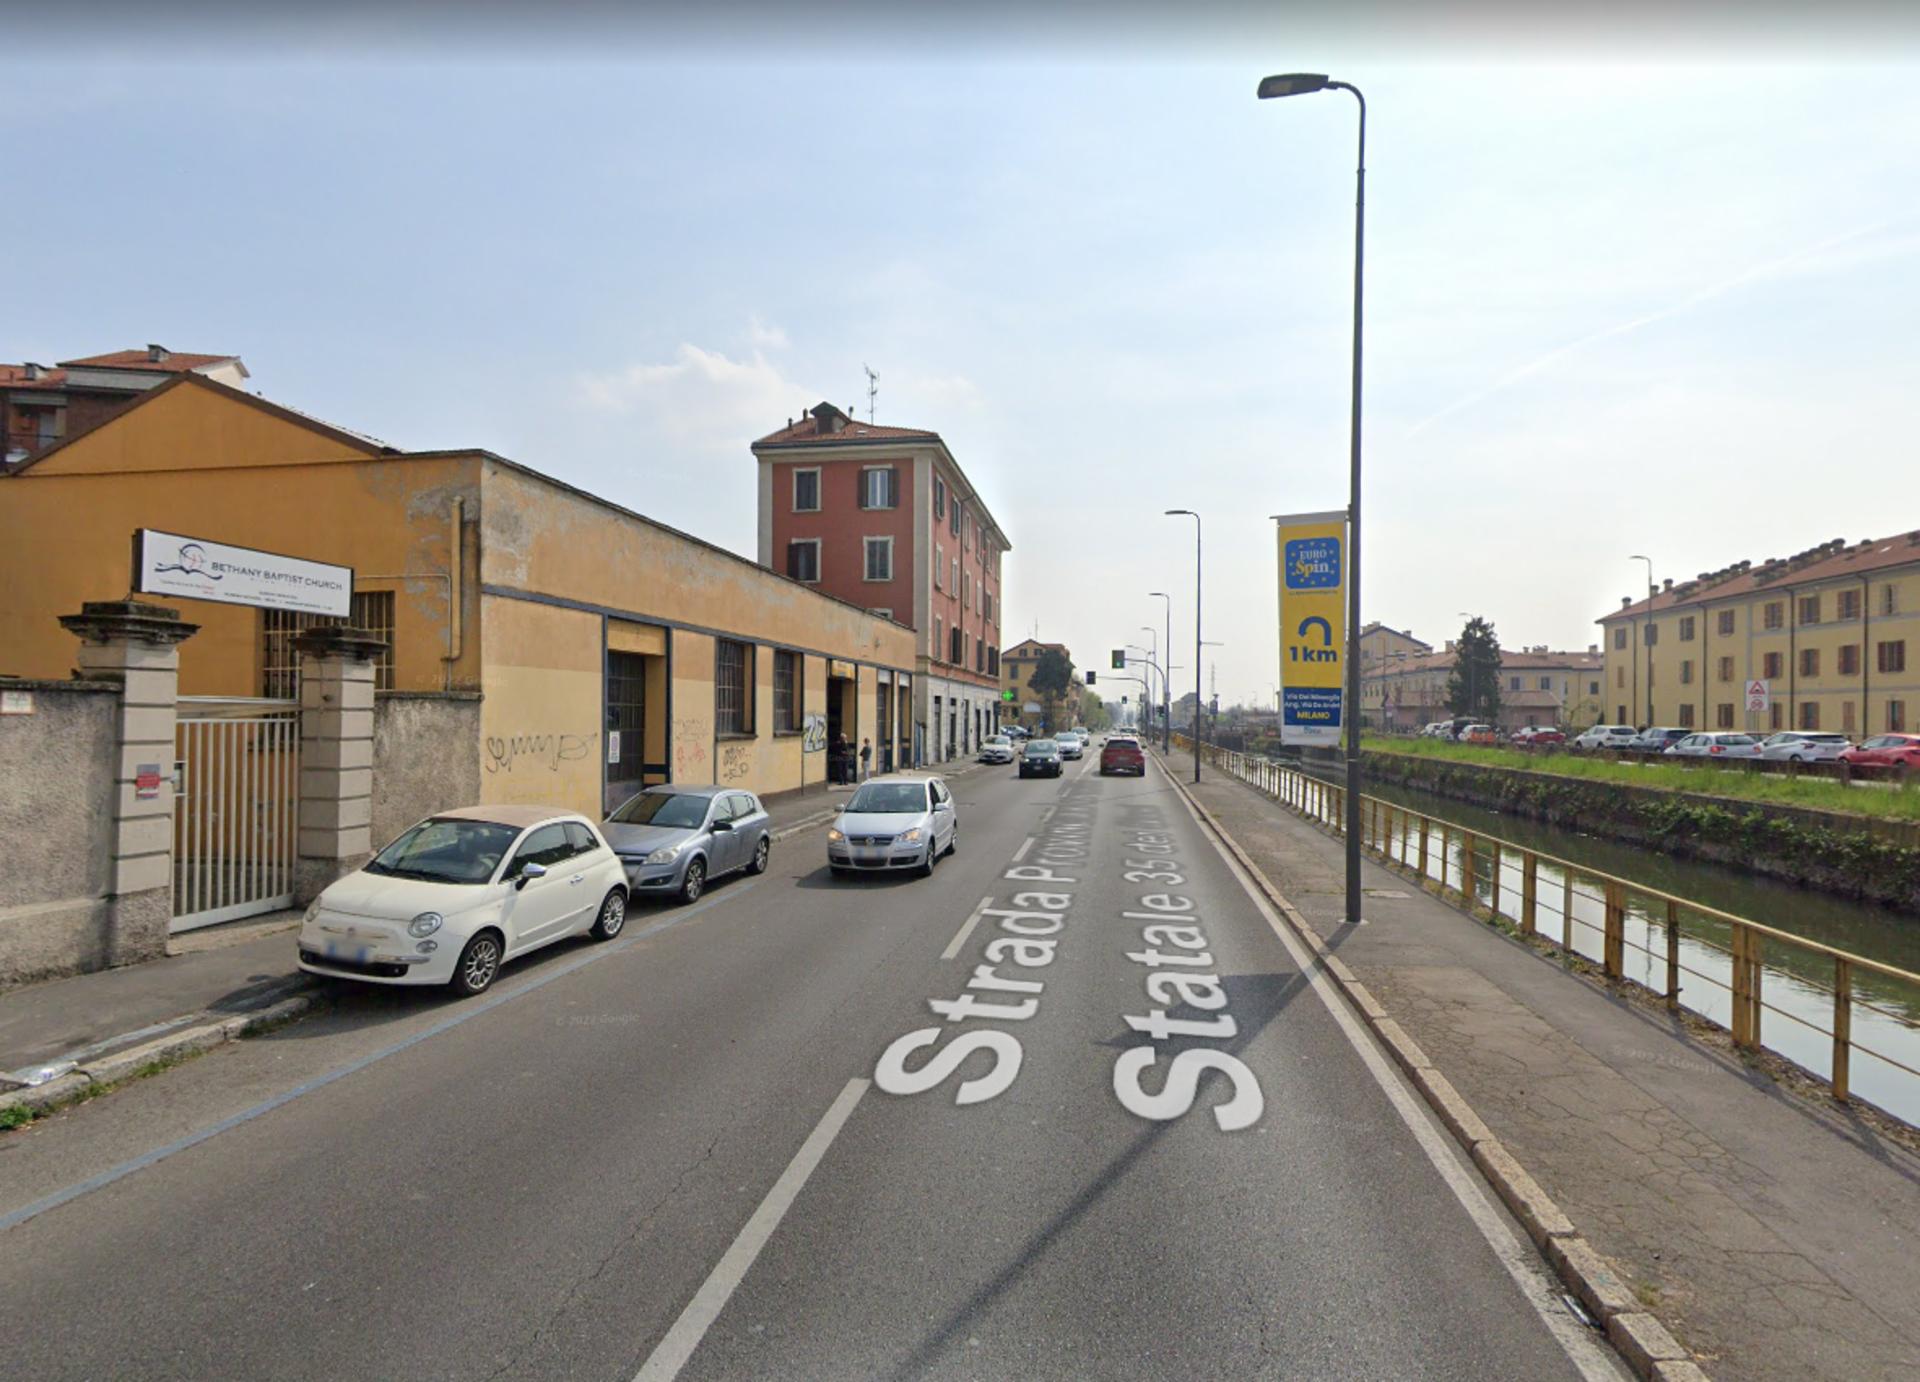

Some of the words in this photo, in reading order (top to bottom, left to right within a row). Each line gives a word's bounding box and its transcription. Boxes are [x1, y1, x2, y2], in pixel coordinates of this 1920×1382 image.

[1299, 548, 1328, 561] EURO
[211, 561, 262, 579] BETHANY
[263, 571, 304, 585] BAPTIST
[304, 577, 343, 591] CHURCH
[1295, 559, 1329, 578] Spin
[1289, 646, 1298, 662] 1
[1302, 646, 1338, 662] km
[1296, 711, 1330, 720] MILANO
